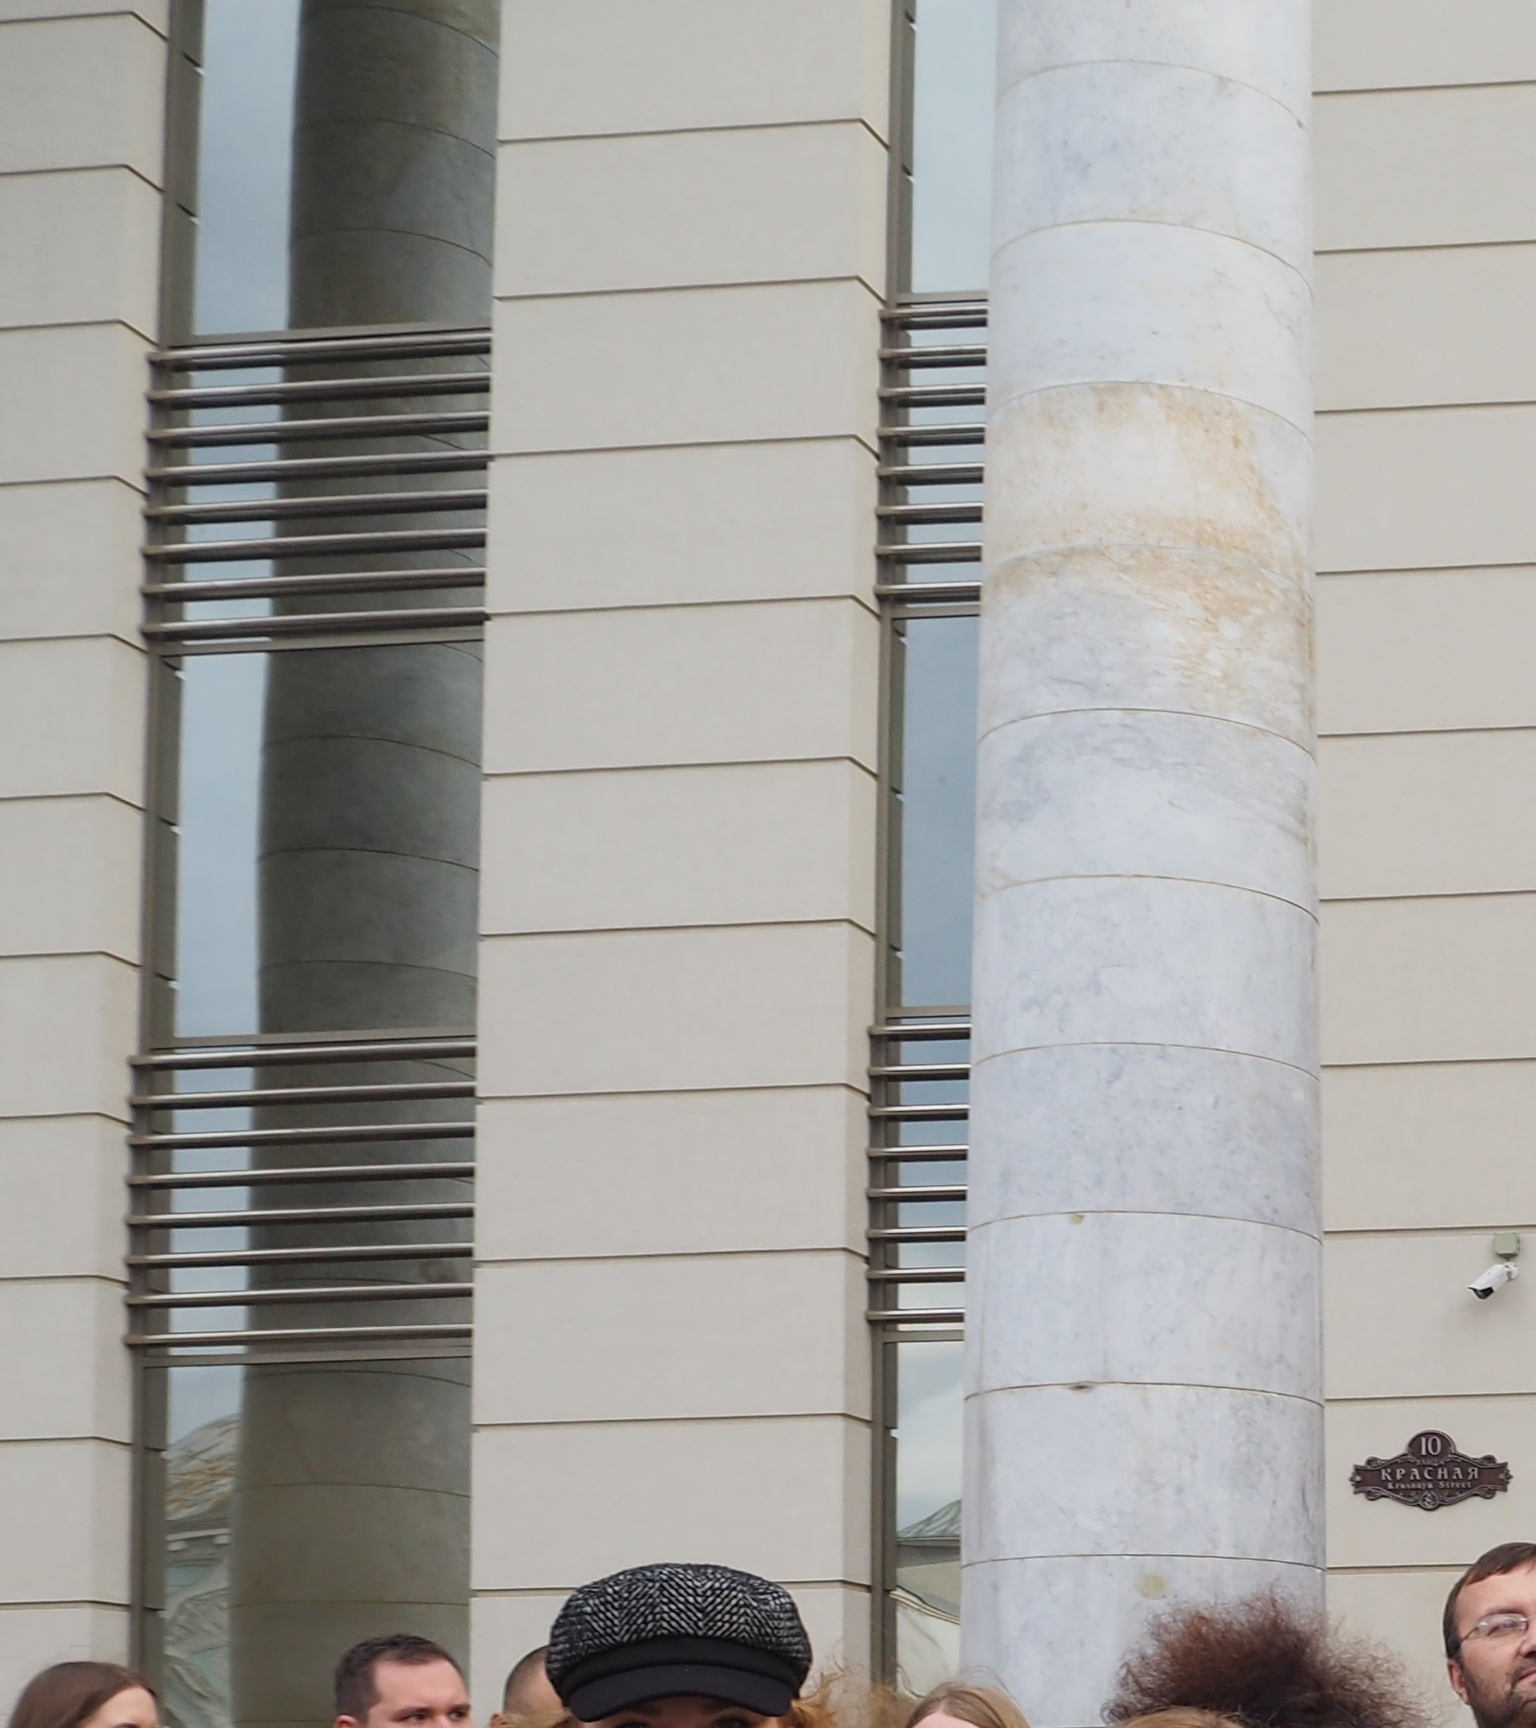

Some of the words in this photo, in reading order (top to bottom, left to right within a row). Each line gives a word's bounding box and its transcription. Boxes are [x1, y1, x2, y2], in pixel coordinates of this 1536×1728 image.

[1420, 1436, 1442, 1456] 10
[1381, 1467, 1479, 1481] КРАСНАЯ
[1438, 1480, 1472, 1489] Street
